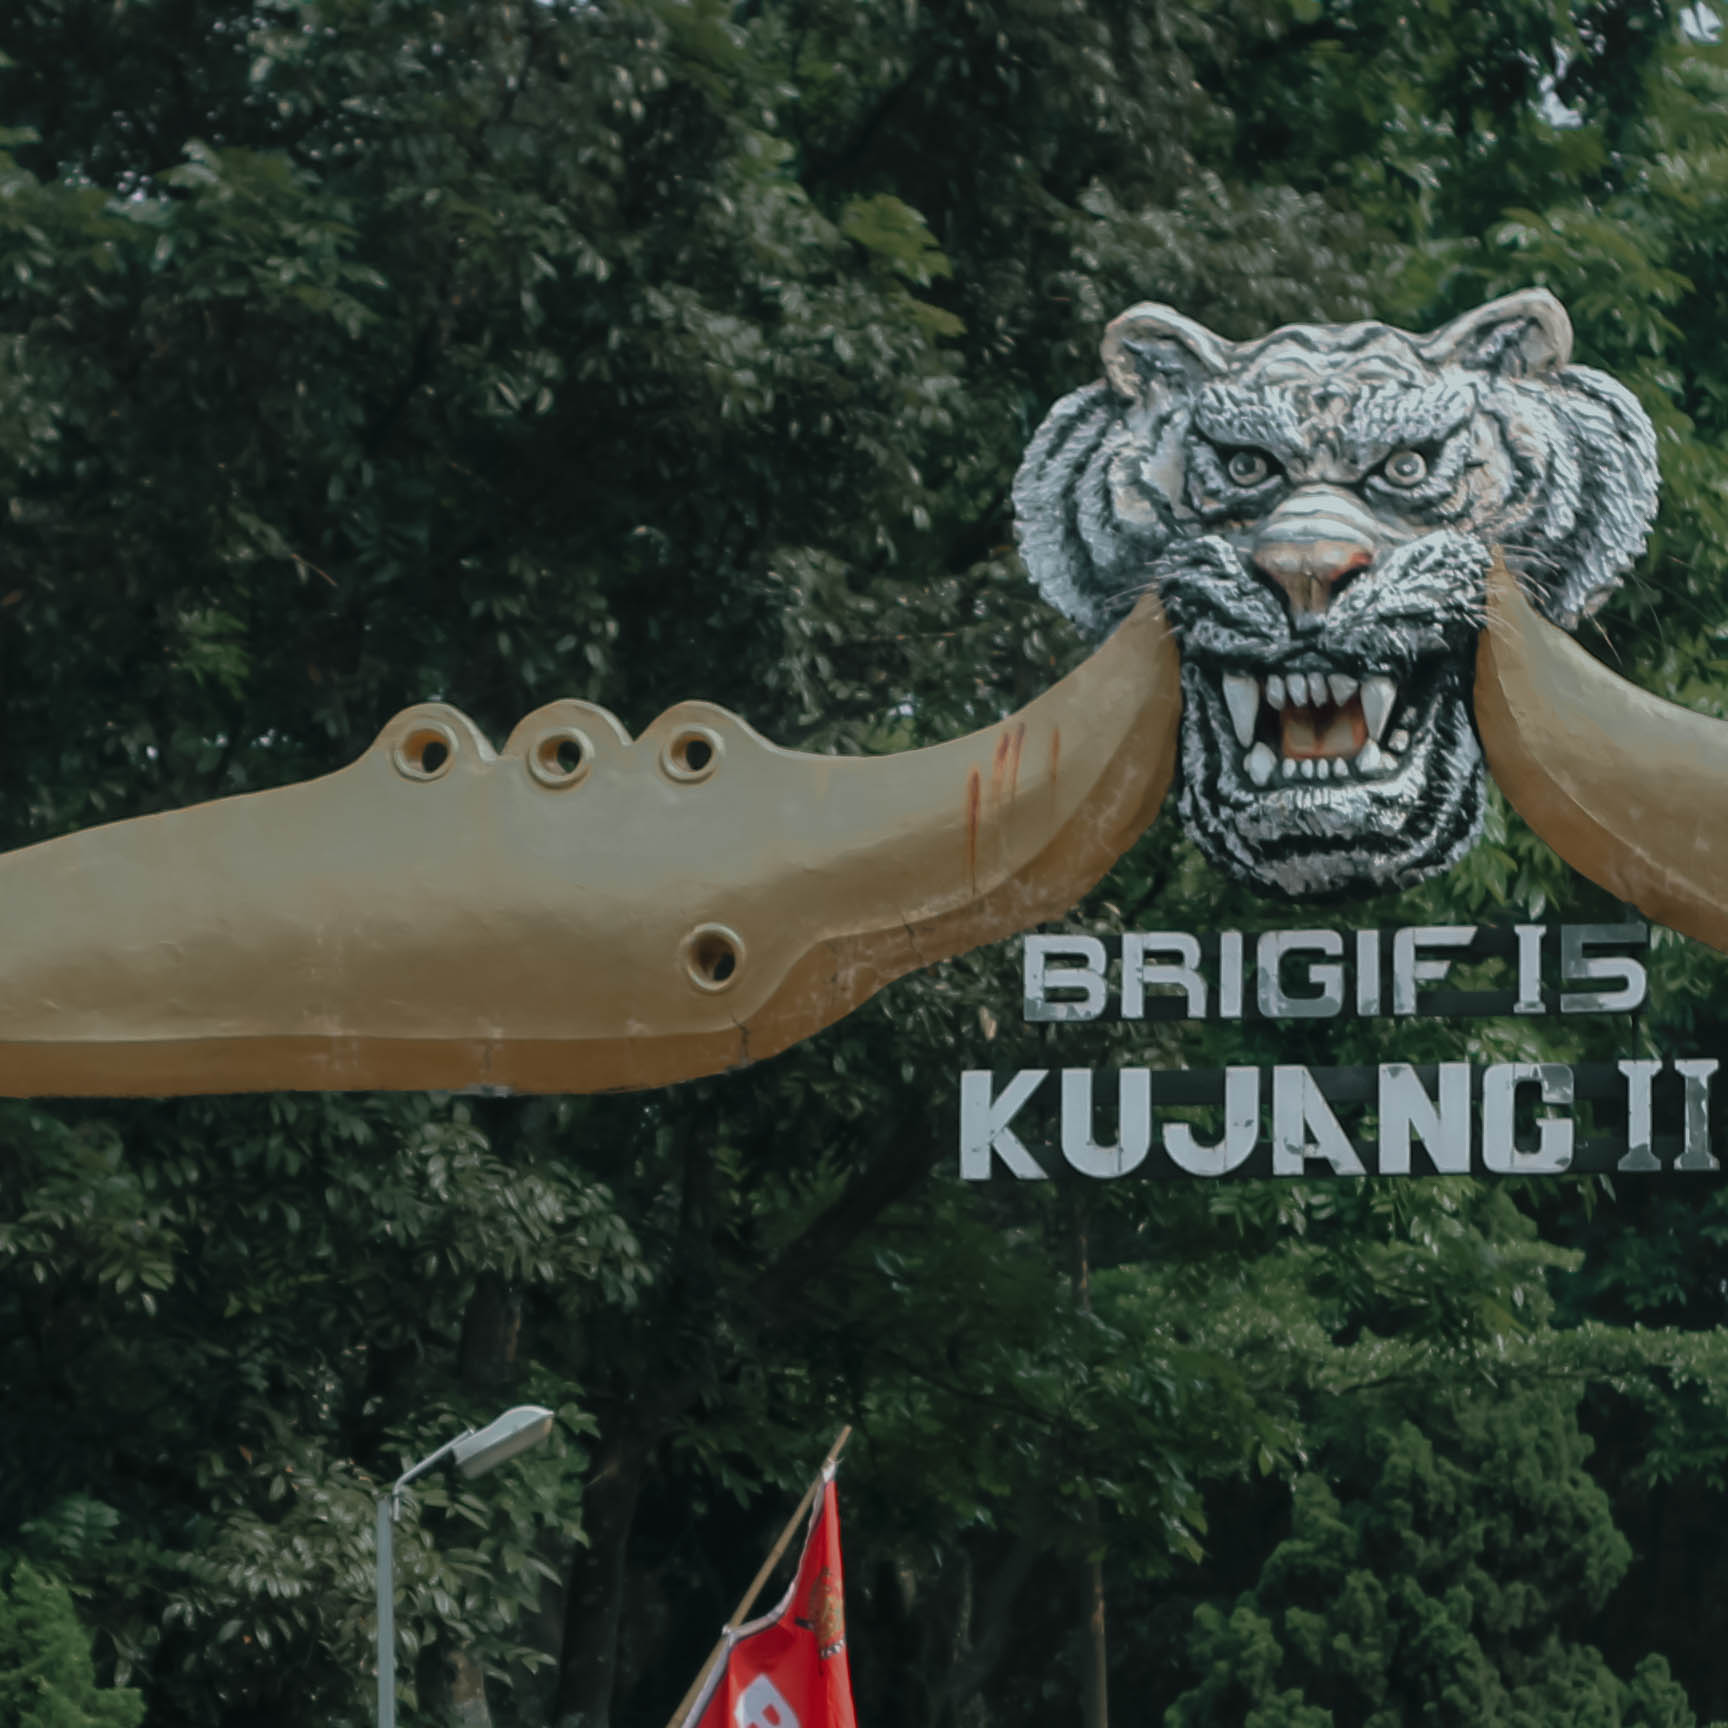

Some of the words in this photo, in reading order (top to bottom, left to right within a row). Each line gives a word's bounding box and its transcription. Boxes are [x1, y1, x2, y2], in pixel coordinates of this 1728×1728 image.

[1022, 924, 1478, 1023] BRIGIF
[959, 1063, 1576, 1181] KUJANG
[1617, 1058, 1721, 1172] II
